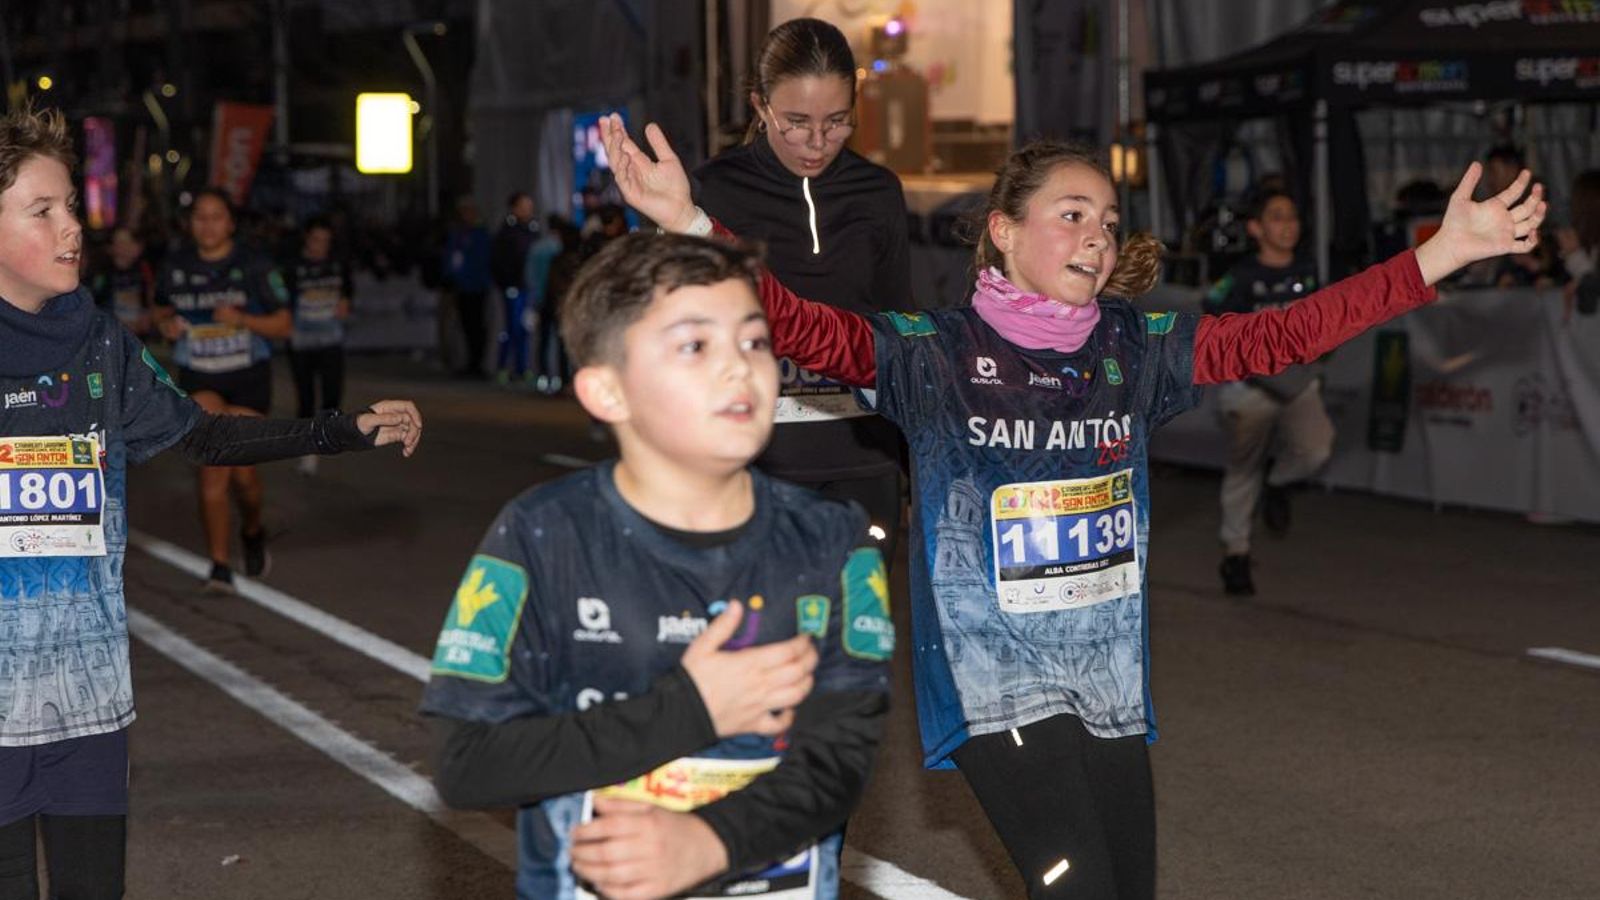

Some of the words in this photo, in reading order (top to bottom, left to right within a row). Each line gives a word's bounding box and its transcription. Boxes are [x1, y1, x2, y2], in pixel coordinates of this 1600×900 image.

[967, 416, 1035, 450] SAN
[1001, 508, 1132, 563] 11139
[1045, 567, 1064, 575] ALBA
